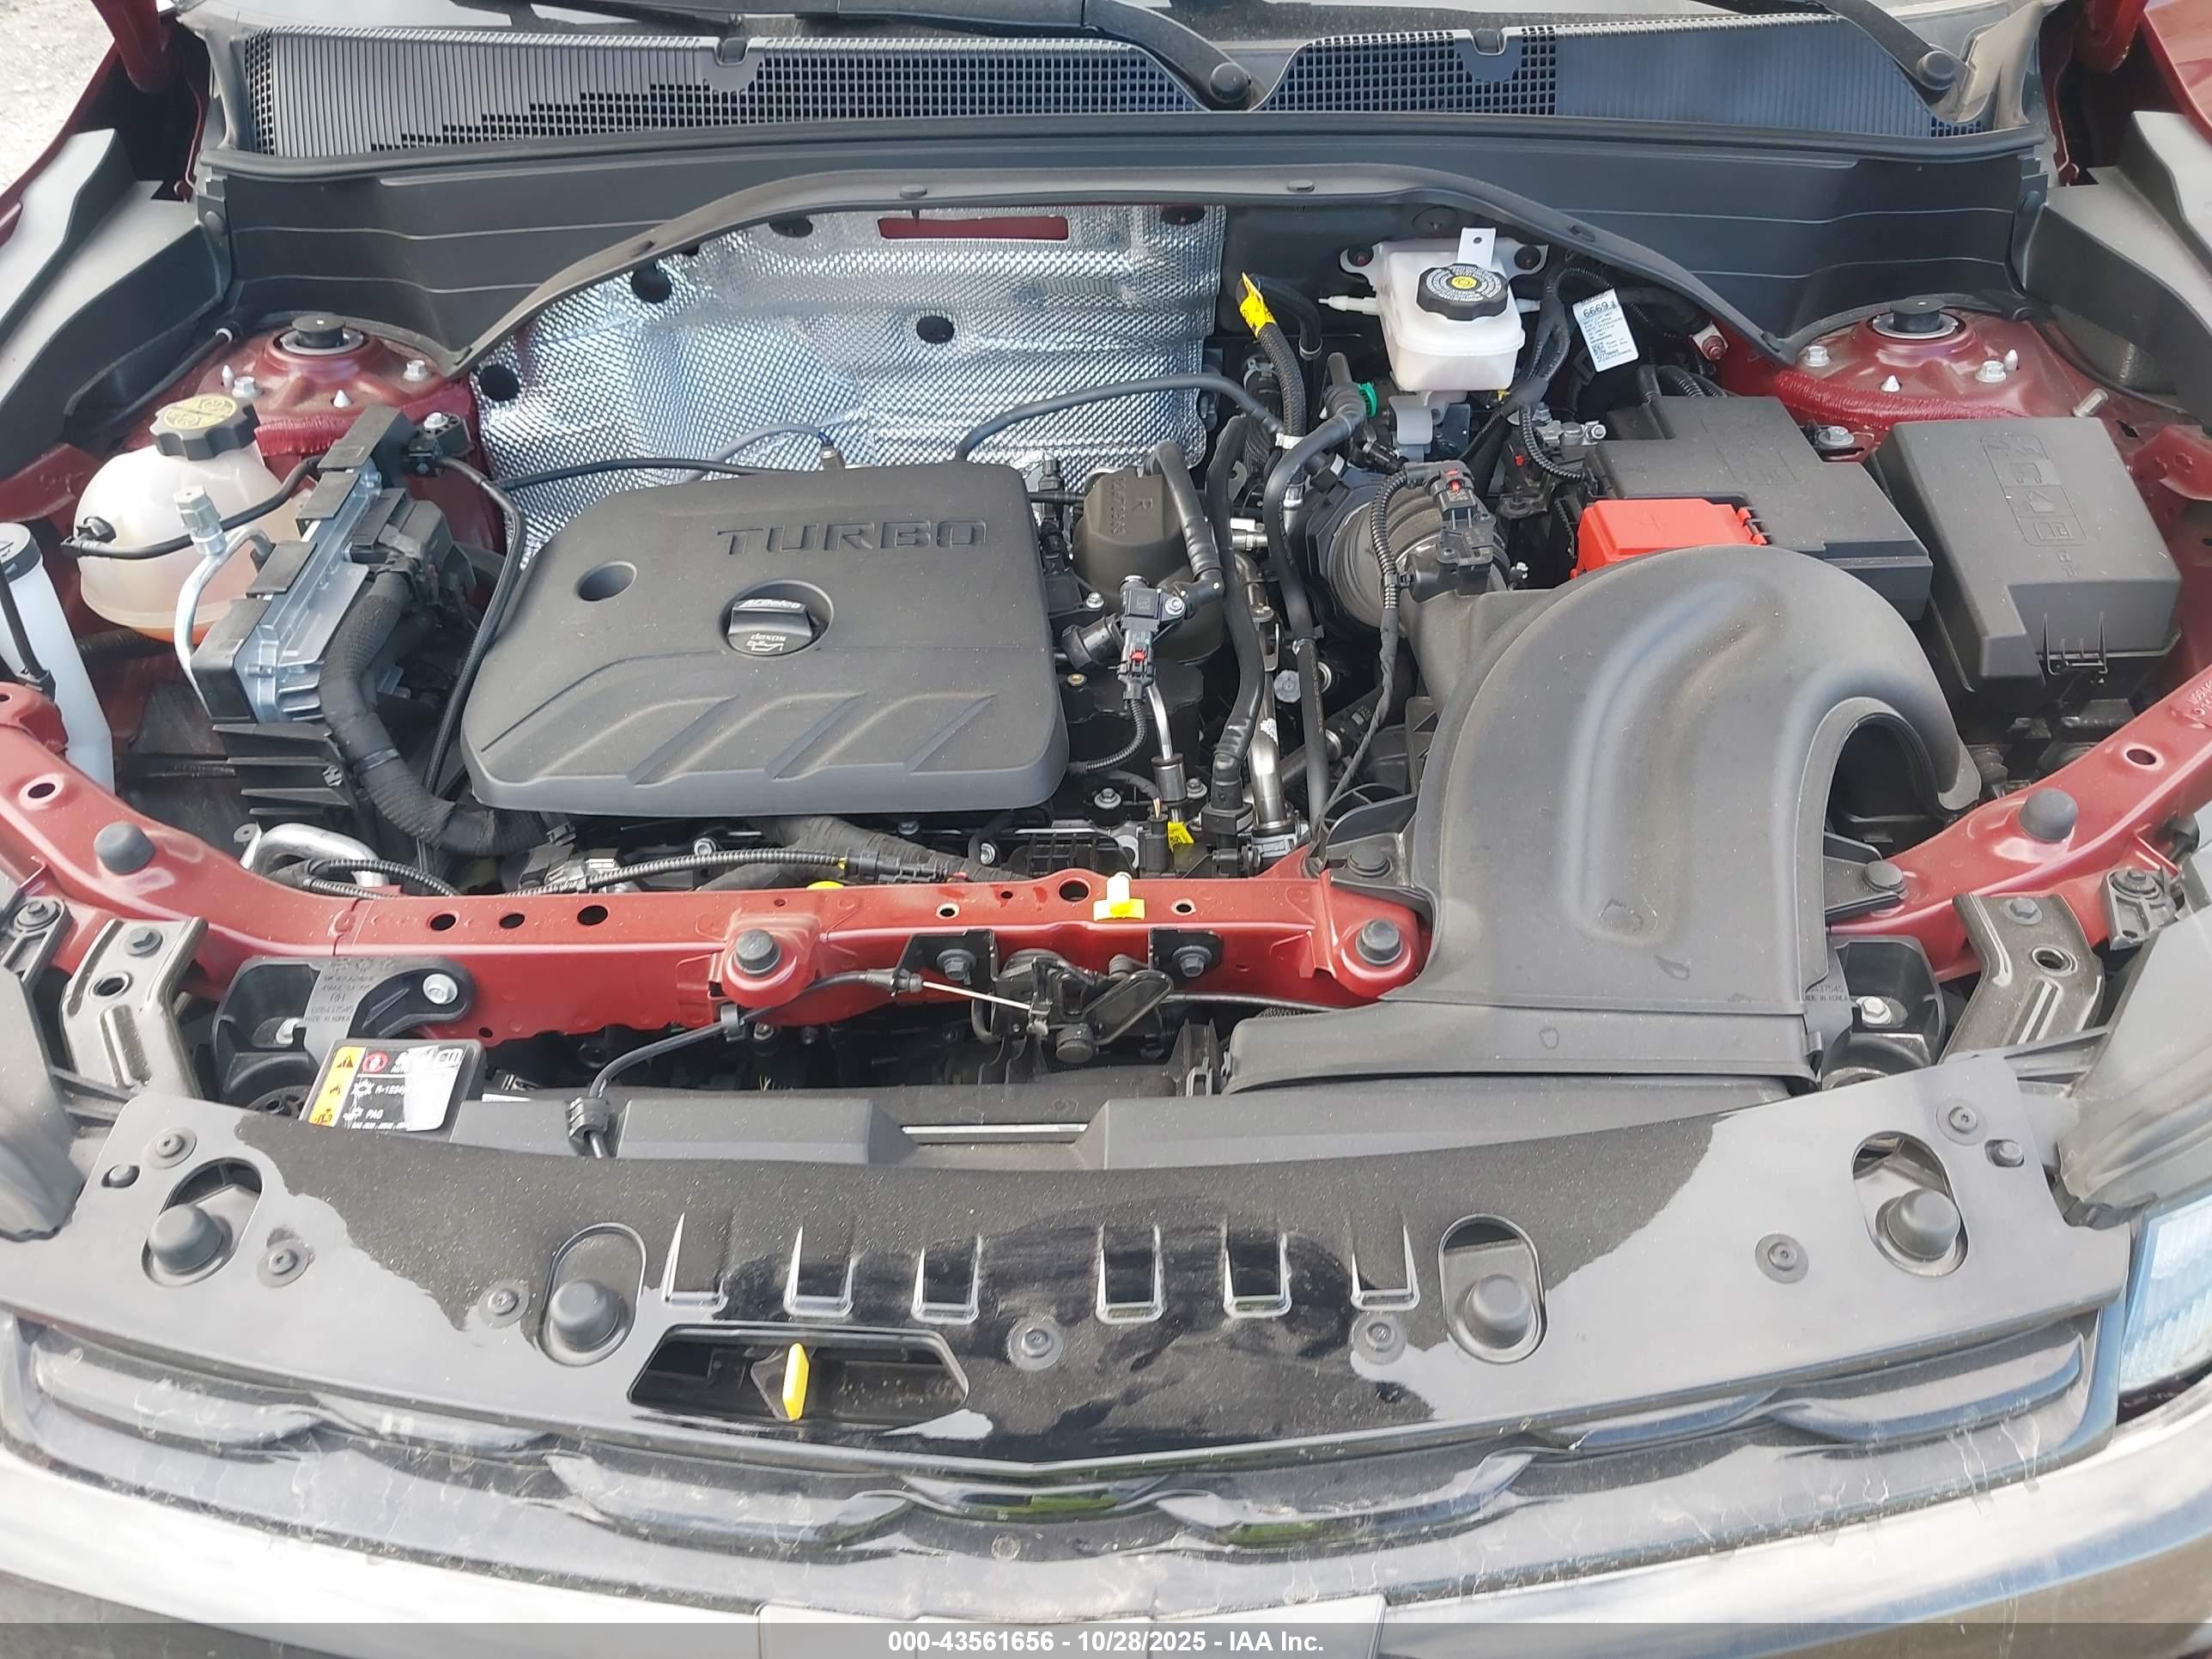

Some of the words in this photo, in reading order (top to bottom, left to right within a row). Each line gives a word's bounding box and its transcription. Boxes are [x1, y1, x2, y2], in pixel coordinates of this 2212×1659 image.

[1583, 301, 1608, 318] 6669
[717, 520, 987, 555] TURBO
[738, 599, 802, 609] ACDelco
[750, 633, 787, 642] dexos
